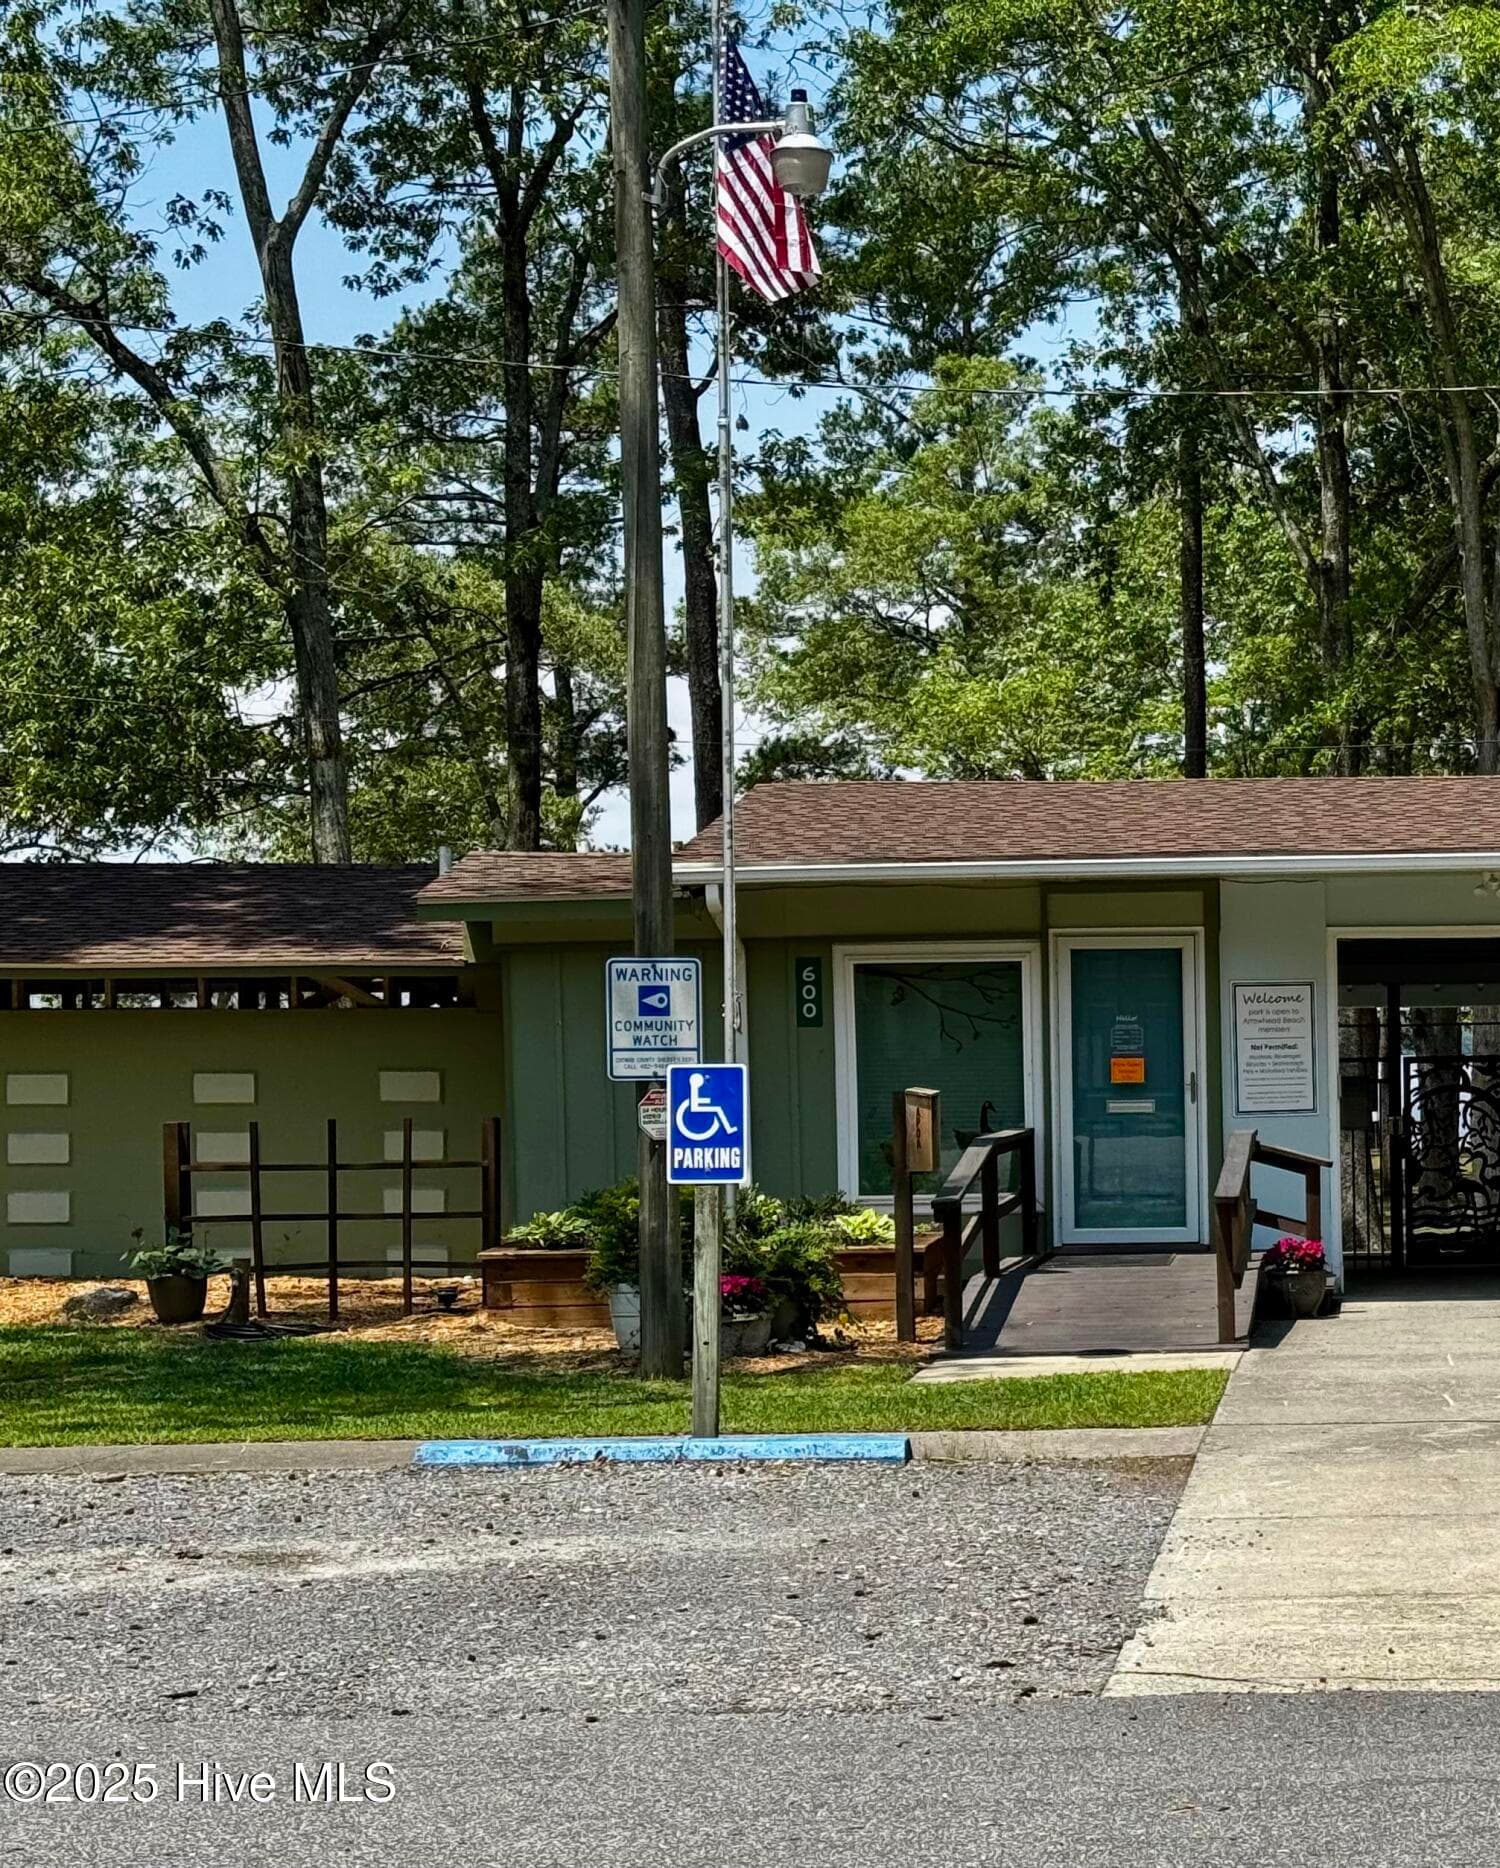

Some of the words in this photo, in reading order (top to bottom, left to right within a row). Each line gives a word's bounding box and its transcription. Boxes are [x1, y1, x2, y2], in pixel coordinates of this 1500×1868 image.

[615, 967, 693, 982] WARNING
[802, 966, 817, 1018] 600
[1242, 992, 1304, 1005] Welcome
[614, 1020, 694, 1032] COMMUNITY
[632, 1034, 678, 1046] WATCH
[673, 1147, 741, 1169] PARKING
